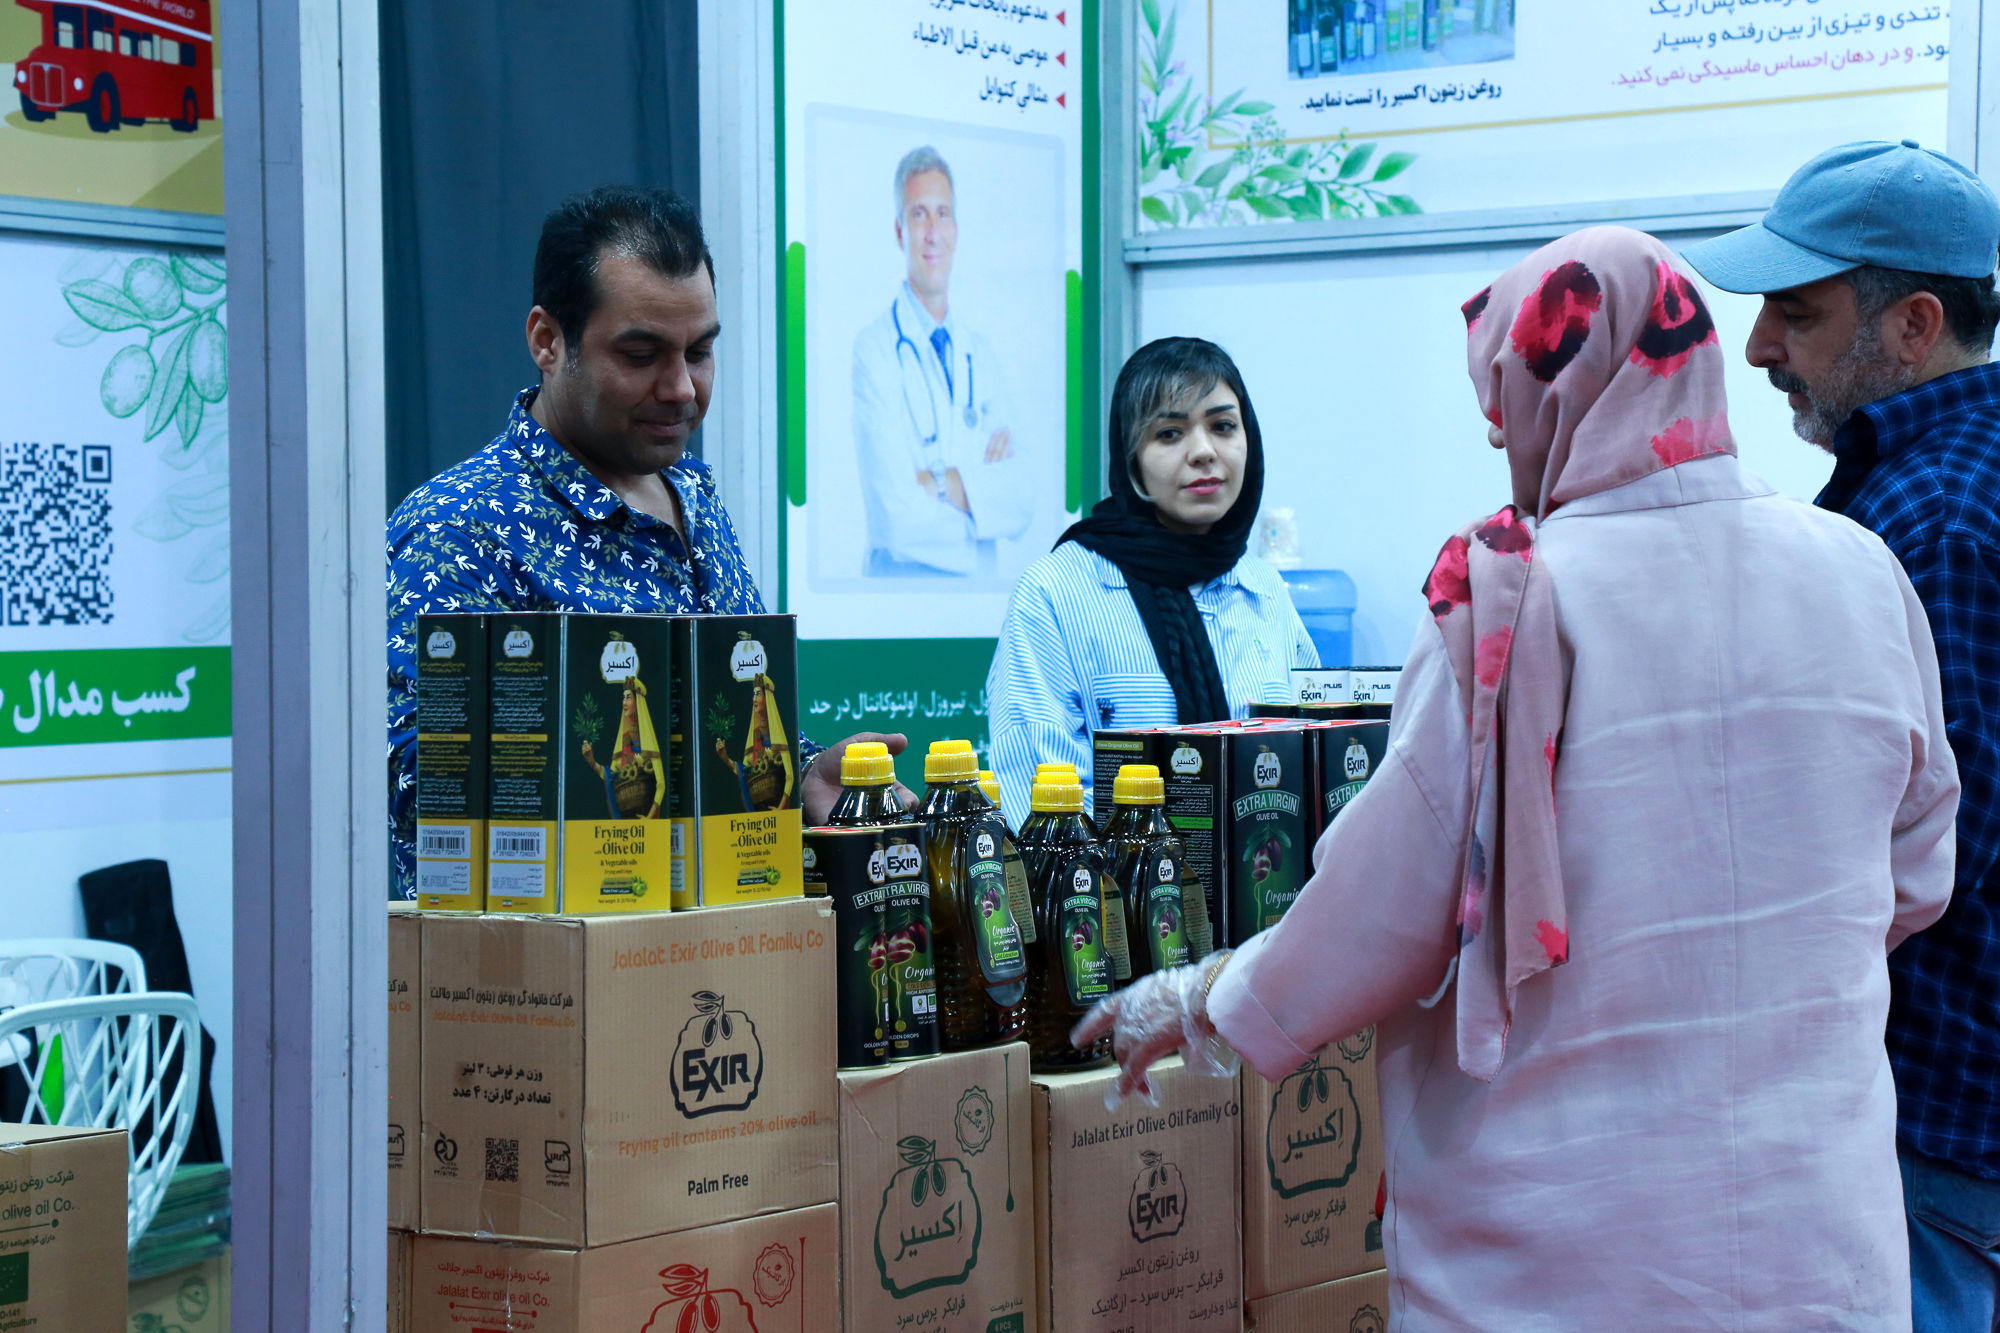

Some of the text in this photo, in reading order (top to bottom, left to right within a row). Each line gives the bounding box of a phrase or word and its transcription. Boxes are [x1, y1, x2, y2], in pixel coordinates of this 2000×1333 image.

[162, 2, 195, 20] WORLD
[1652, 5, 1941, 53] تندی و تیزی از بین رفته و بسیار
[955, 29, 978, 54] قبل
[1830, 51, 1875, 70] دهان
[1878, 48, 1899, 66] در
[1904, 47, 1914, 62] و
[1688, 58, 1761, 83] ماسیدگی
[1764, 51, 1828, 76] احساس
[1656, 69, 1685, 86] نمی
[1344, 78, 1502, 108] روغن زیتون اکسیر را تست
[605, 656, 636, 673] اکسیر
[735, 653, 763, 671] اکسیر
[13, 666, 197, 734] کسب مدال
[809, 697, 850, 721] در حد
[1236, 792, 1298, 817] EXTRA VIRGIN
[1329, 787, 1356, 808] EXTRA
[730, 816, 777, 833] Frying Oil
[1256, 812, 1279, 821] OLIVE OIL
[594, 825, 645, 841] Frying Oil
[738, 833, 763, 847] Olive
[763, 832, 777, 845] Oil
[602, 841, 645, 855] Olive Oil
[971, 863, 1001, 877] EXTRA VIRGIN
[1164, 887, 1180, 896] VIRGIN
[1265, 887, 1300, 908] Organic
[892, 899, 911, 907] OLIVE
[1064, 899, 1098, 909] EXTRA VIRGIN
[992, 925, 1015, 938] Organic
[612, 929, 824, 970] Jalalat Exir Olive Oil Family Co
[1167, 946, 1188, 958] Organic
[904, 964, 935, 981] Organi
[1081, 958, 1106, 971] Organic
[452, 987, 475, 1002] اکسیر
[476, 990, 495, 1005] زیتون
[498, 991, 516, 1006] روغن
[517, 989, 548, 1007] خانوادگی
[549, 994, 574, 1010] شرکت
[399, 1001, 412, 1013] Co
[531, 1014, 561, 1027] Family
[462, 1062, 475, 1076] لیتر
[515, 1068, 525, 1079] هر
[527, 1068, 543, 1081] وزن
[452, 1087, 471, 1098] عدد
[513, 1092, 525, 1105] در
[527, 1091, 552, 1104] تعداد
[1072, 1100, 1239, 1149] Jalalat Exir Olive Oil Family Co
[618, 1110, 817, 1157] Frying oil contains 20% olive oil
[0, 1169, 75, 1196] شرکت روغن زیتو
[687, 1173, 749, 1196] Palm Free
[2, 1197, 75, 1221] olive oil Co.
[1284, 1197, 1347, 1229] فرابکر پرس سرد
[1300, 1229, 1330, 1247] ارگانیک
[1117, 1247, 1200, 1281] روغن زیتون اکسیر
[438, 1261, 550, 1286] شرکت زیتون اکسیر جلالت
[437, 1284, 550, 1307] Jalalat Exir olie oil Co.
[1091, 1271, 1224, 1316] فرابکر پرس سرد ارگانیک
[896, 1294, 966, 1329] فرابکر پرس سرد
